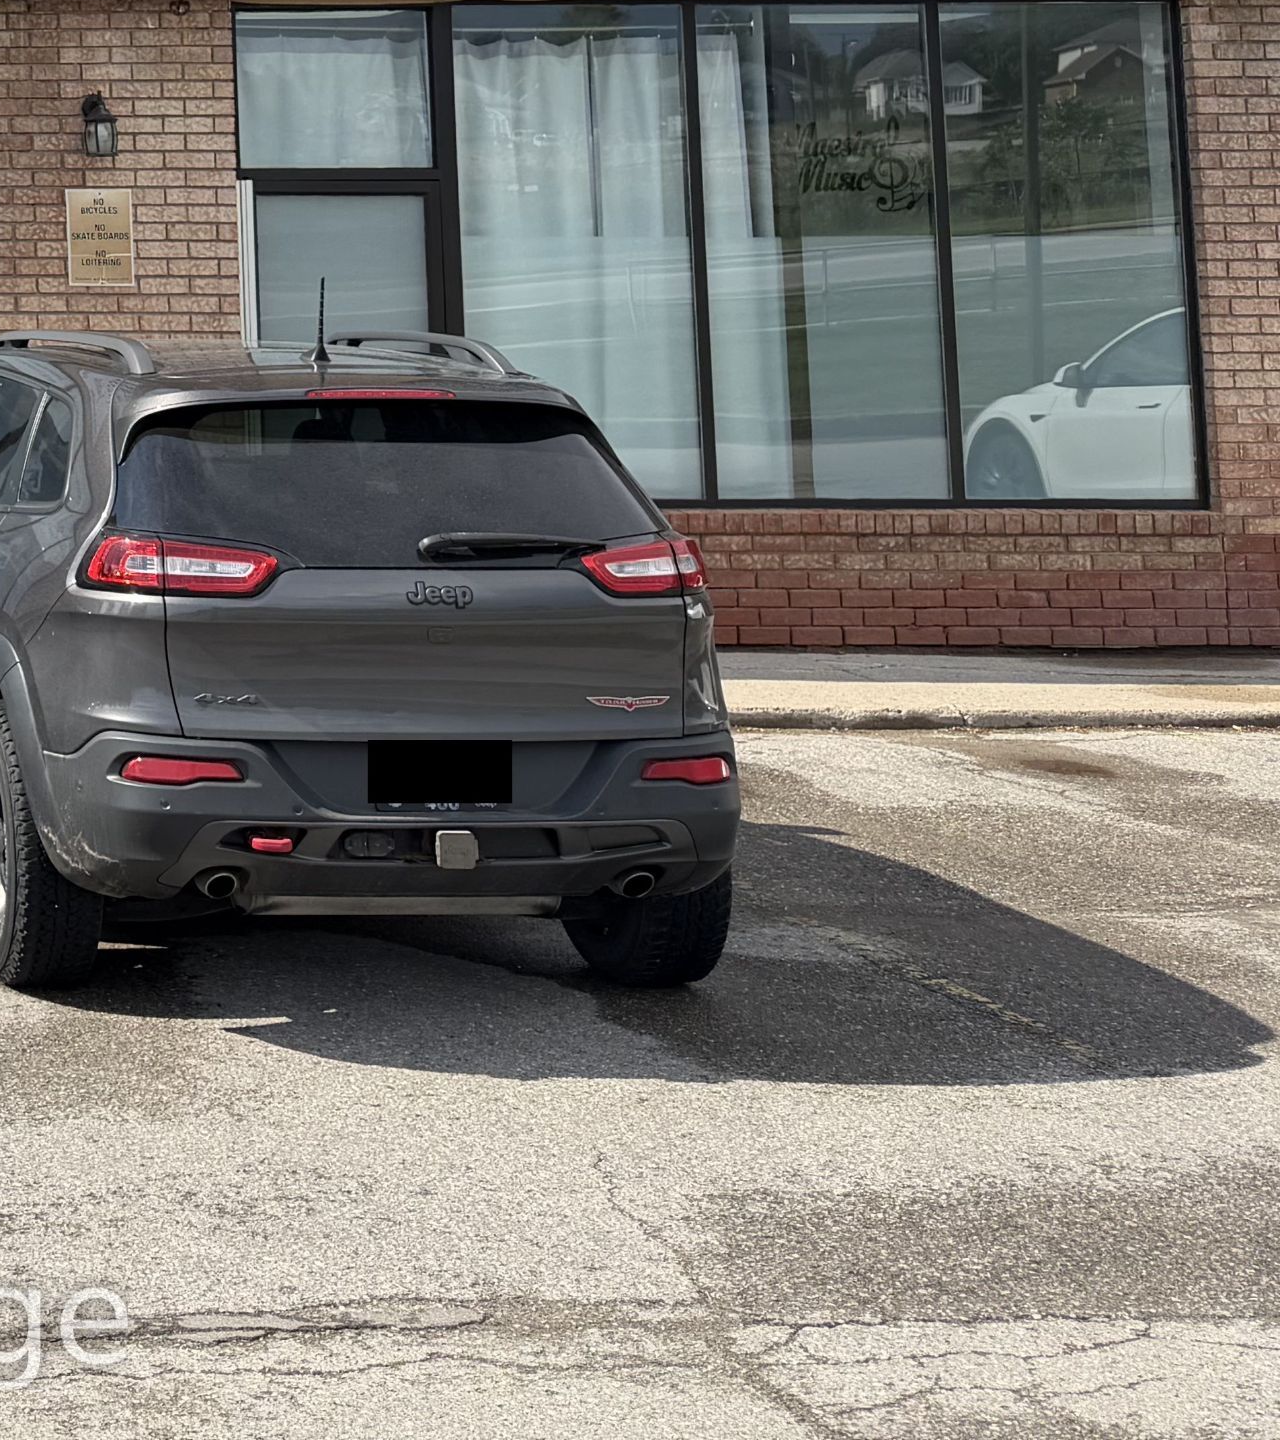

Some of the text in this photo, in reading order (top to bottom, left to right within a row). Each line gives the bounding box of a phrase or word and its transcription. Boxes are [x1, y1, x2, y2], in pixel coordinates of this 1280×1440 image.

[797, 156, 873, 194] Music
[93, 198, 104, 206] NO
[80, 206, 118, 215] BICYCLES
[94, 224, 106, 232] NO
[71, 232, 130, 241] SKATE BOARDS
[95, 250, 107, 258] NO
[81, 258, 122, 267] LOITERING
[406, 581, 474, 609] Jeep
